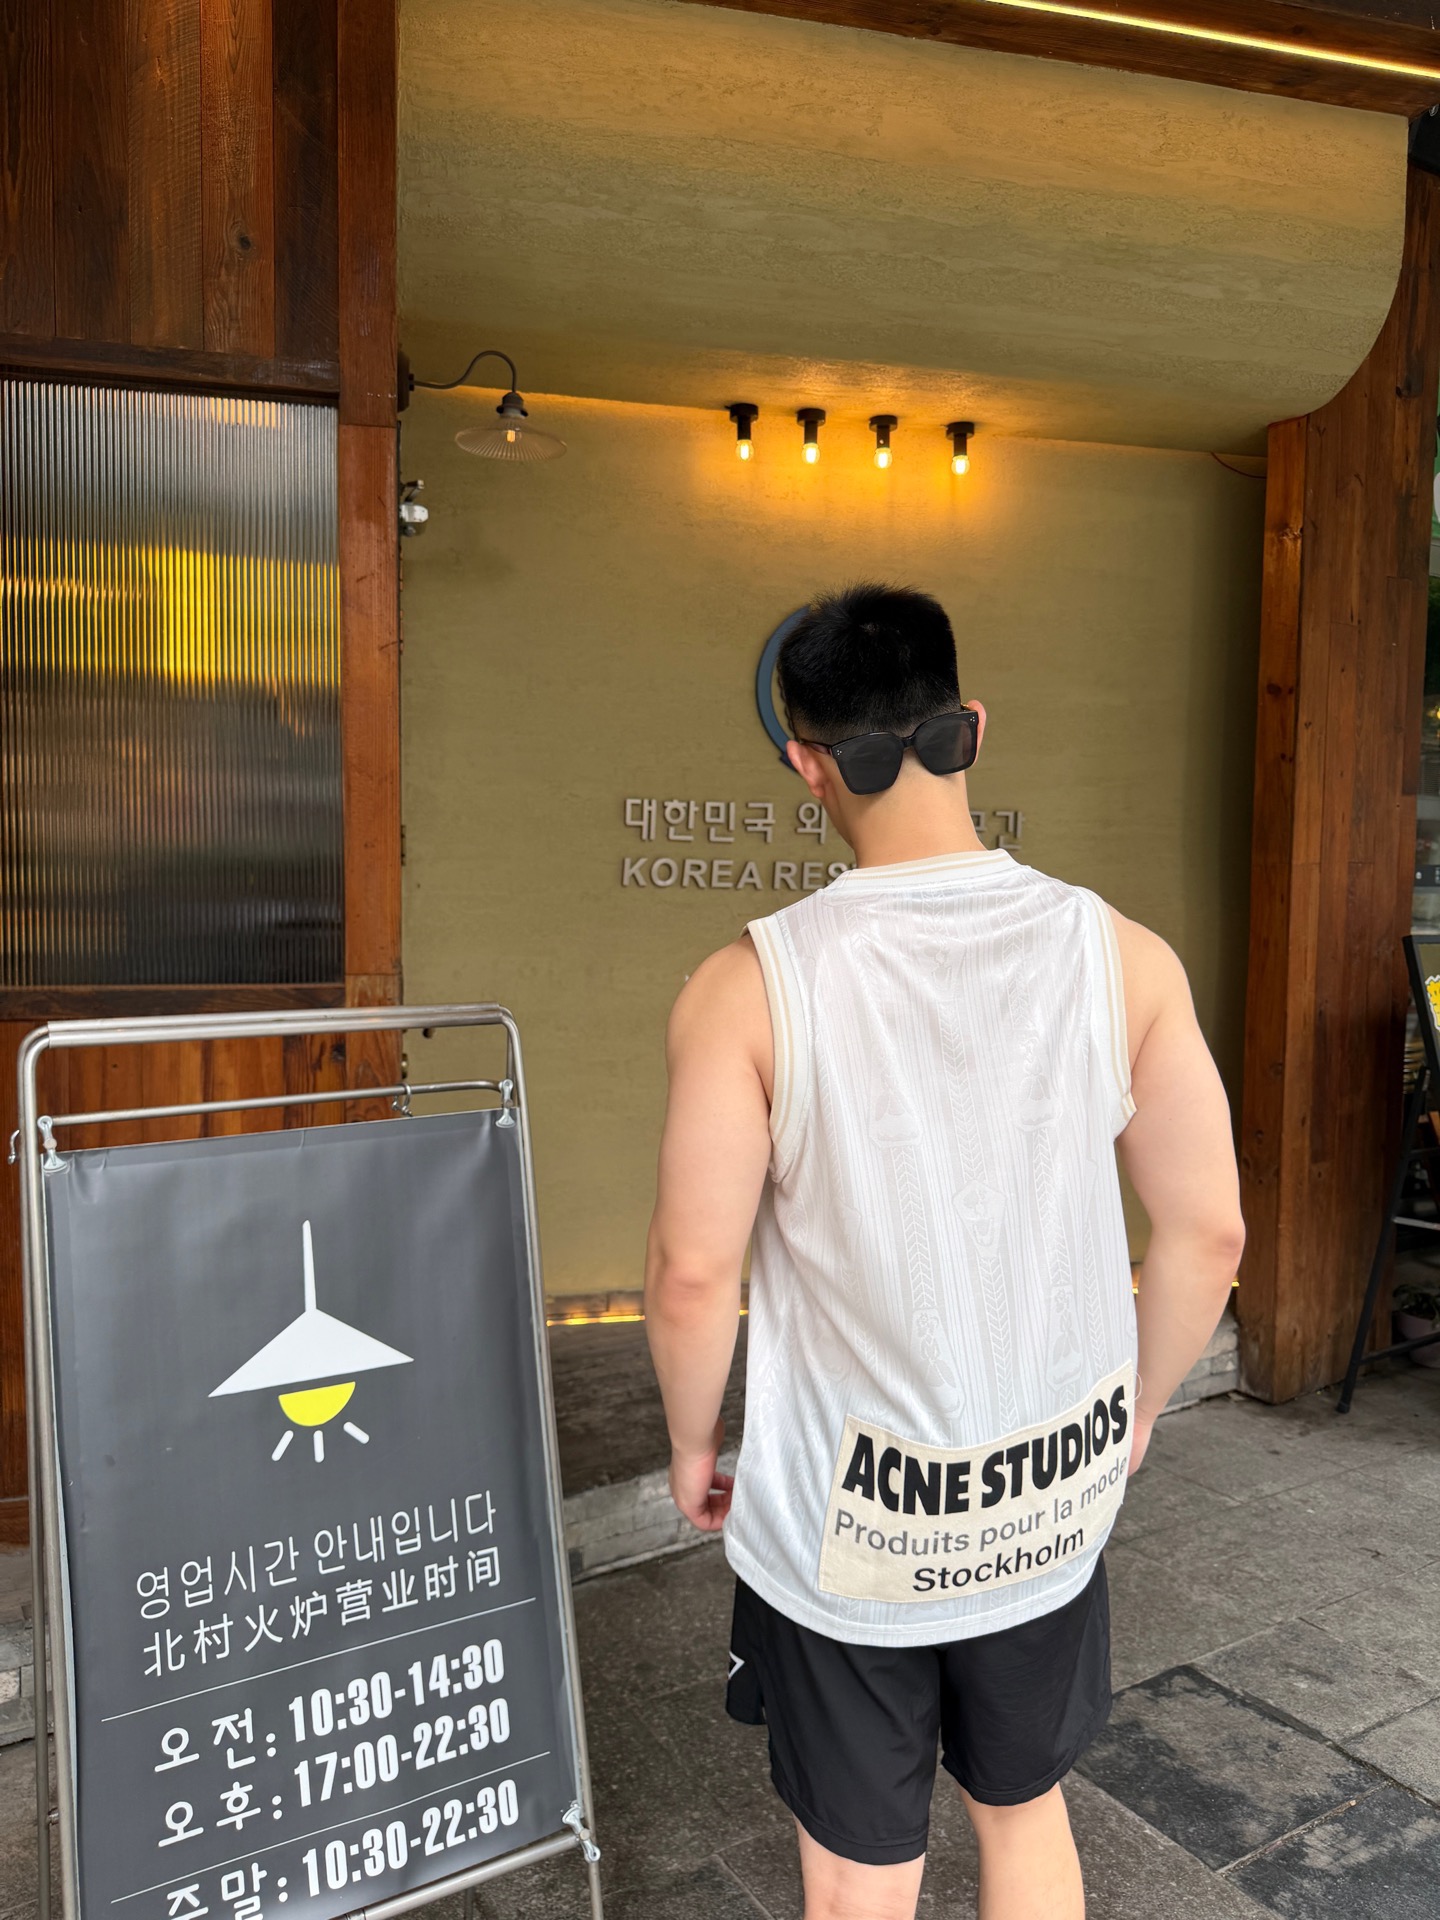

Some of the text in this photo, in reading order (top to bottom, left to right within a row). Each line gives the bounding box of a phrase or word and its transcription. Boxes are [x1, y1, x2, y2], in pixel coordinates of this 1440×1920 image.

[622, 857, 764, 890] KOREA
[624, 798, 776, 844] 대한민국
[841, 1384, 1128, 1516] ACNE STUDIOS
[136, 1490, 497, 1620] 영업시간 안내입니다
[834, 1456, 1128, 1556] Produits pour la mode
[143, 1546, 502, 1677] 北村火炉营业时间
[912, 1527, 1085, 1593] Stockholm
[288, 1638, 505, 1743] 10:30-14:30
[294, 1698, 511, 1808] 17:00-22:30
[302, 1779, 519, 1898] 10:30-22:30
